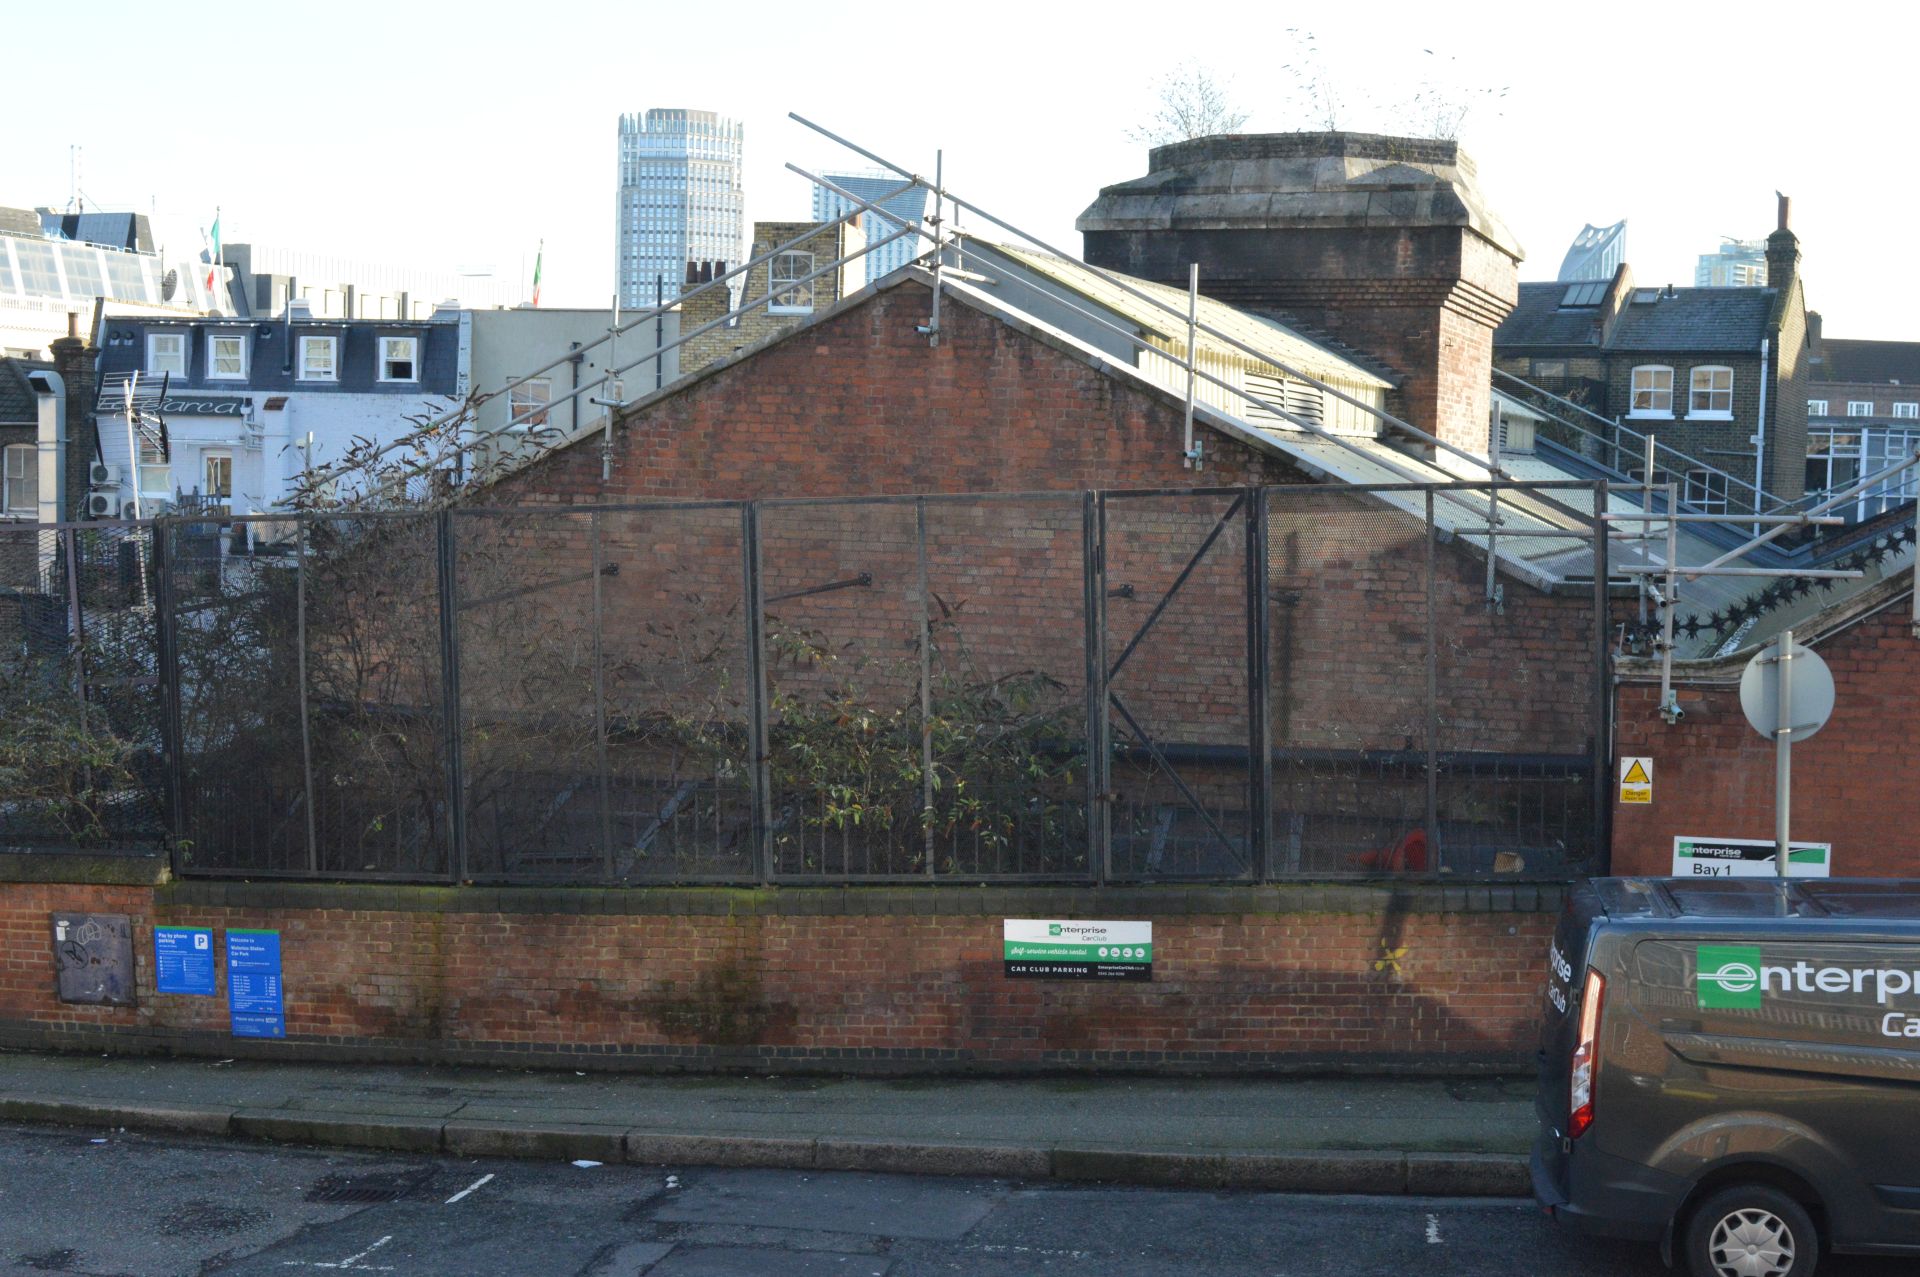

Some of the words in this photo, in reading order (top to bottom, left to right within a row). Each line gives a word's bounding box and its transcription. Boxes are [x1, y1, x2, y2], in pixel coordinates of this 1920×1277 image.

[1680, 845, 1741, 856] enterprise
[1693, 863, 1719, 877] Bay
[1725, 864, 1731, 876] 1
[1050, 925, 1107, 935] enterprise
[198, 937, 204, 947] P
